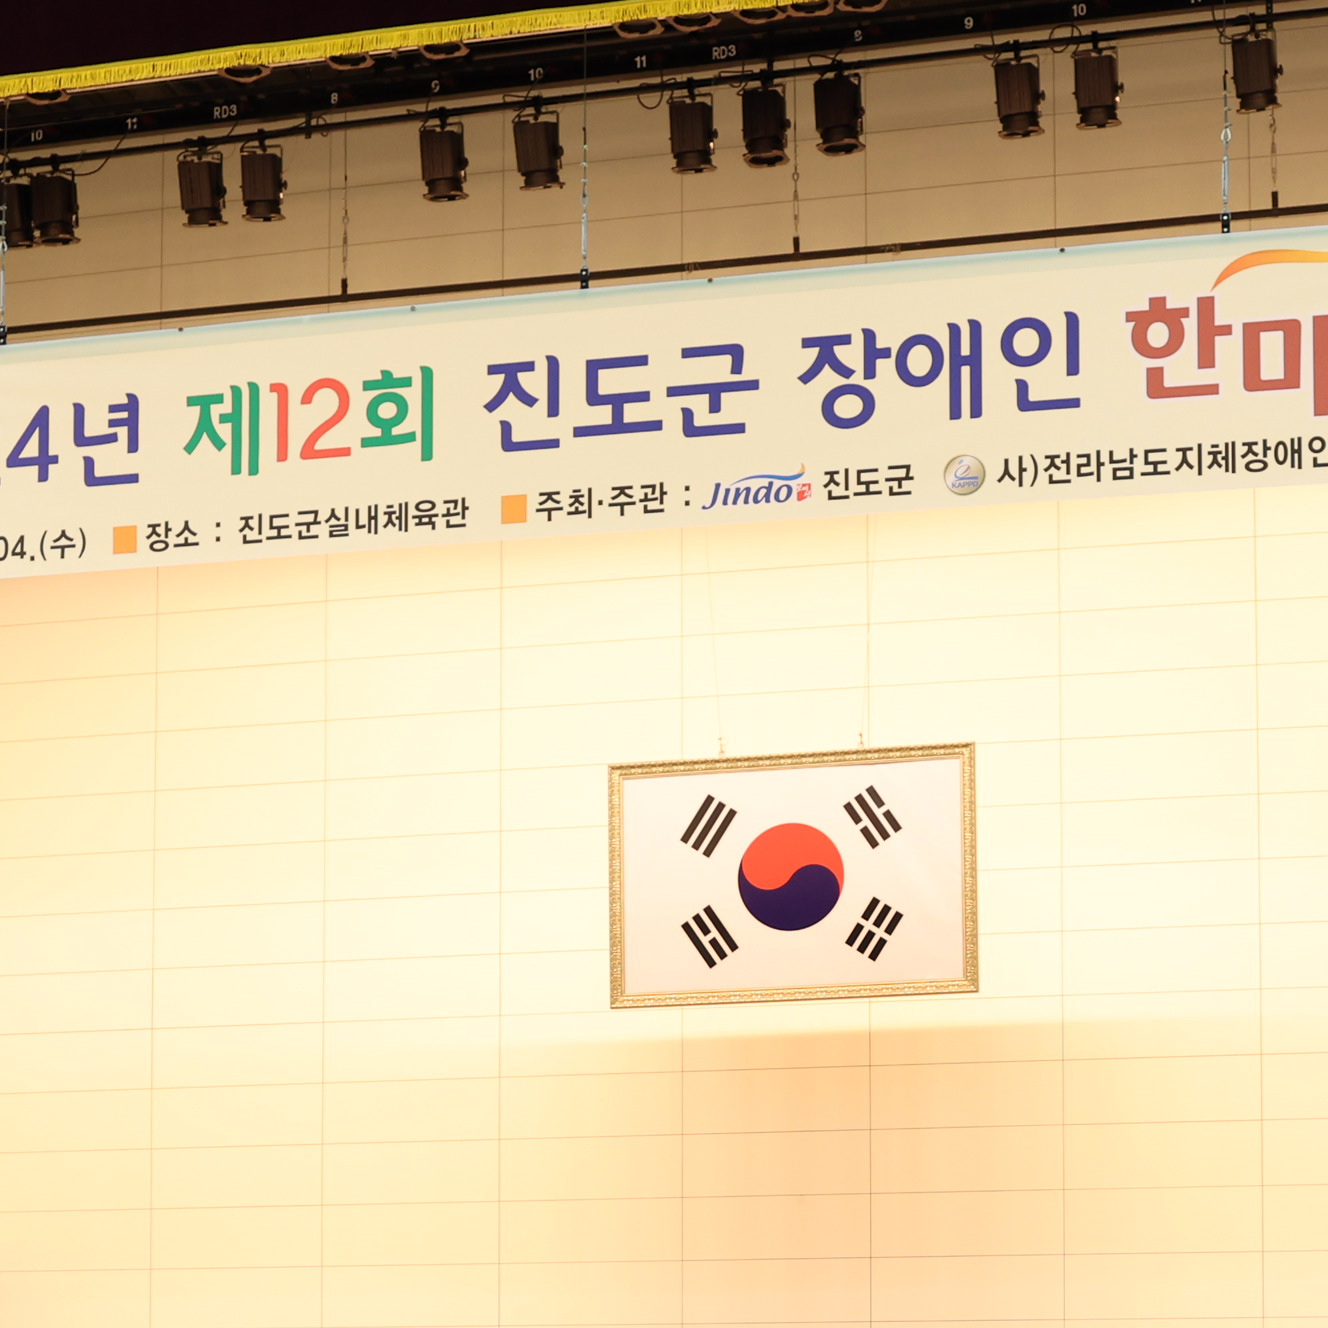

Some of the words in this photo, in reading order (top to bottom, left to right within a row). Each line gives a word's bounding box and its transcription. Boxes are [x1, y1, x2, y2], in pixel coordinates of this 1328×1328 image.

[30, 129, 44, 142] 10
[213, 104, 238, 120] RD3
[528, 67, 544, 82] 10
[635, 54, 648, 69] 11
[712, 44, 737, 60] RD3
[964, 16, 974, 30] 9
[1072, 4, 1087, 17] 10
[183, 366, 434, 477] 제12회
[483, 344, 760, 453] 진도군
[797, 311, 1081, 430] 장애인
[535, 482, 668, 523] 주최·주관
[702, 477, 794, 510] Jindo
[822, 463, 915, 503] 진도군
[951, 479, 979, 490] KAPPD
[145, 518, 200, 555] 장소
[238, 497, 470, 547] 진도군실내체육관
